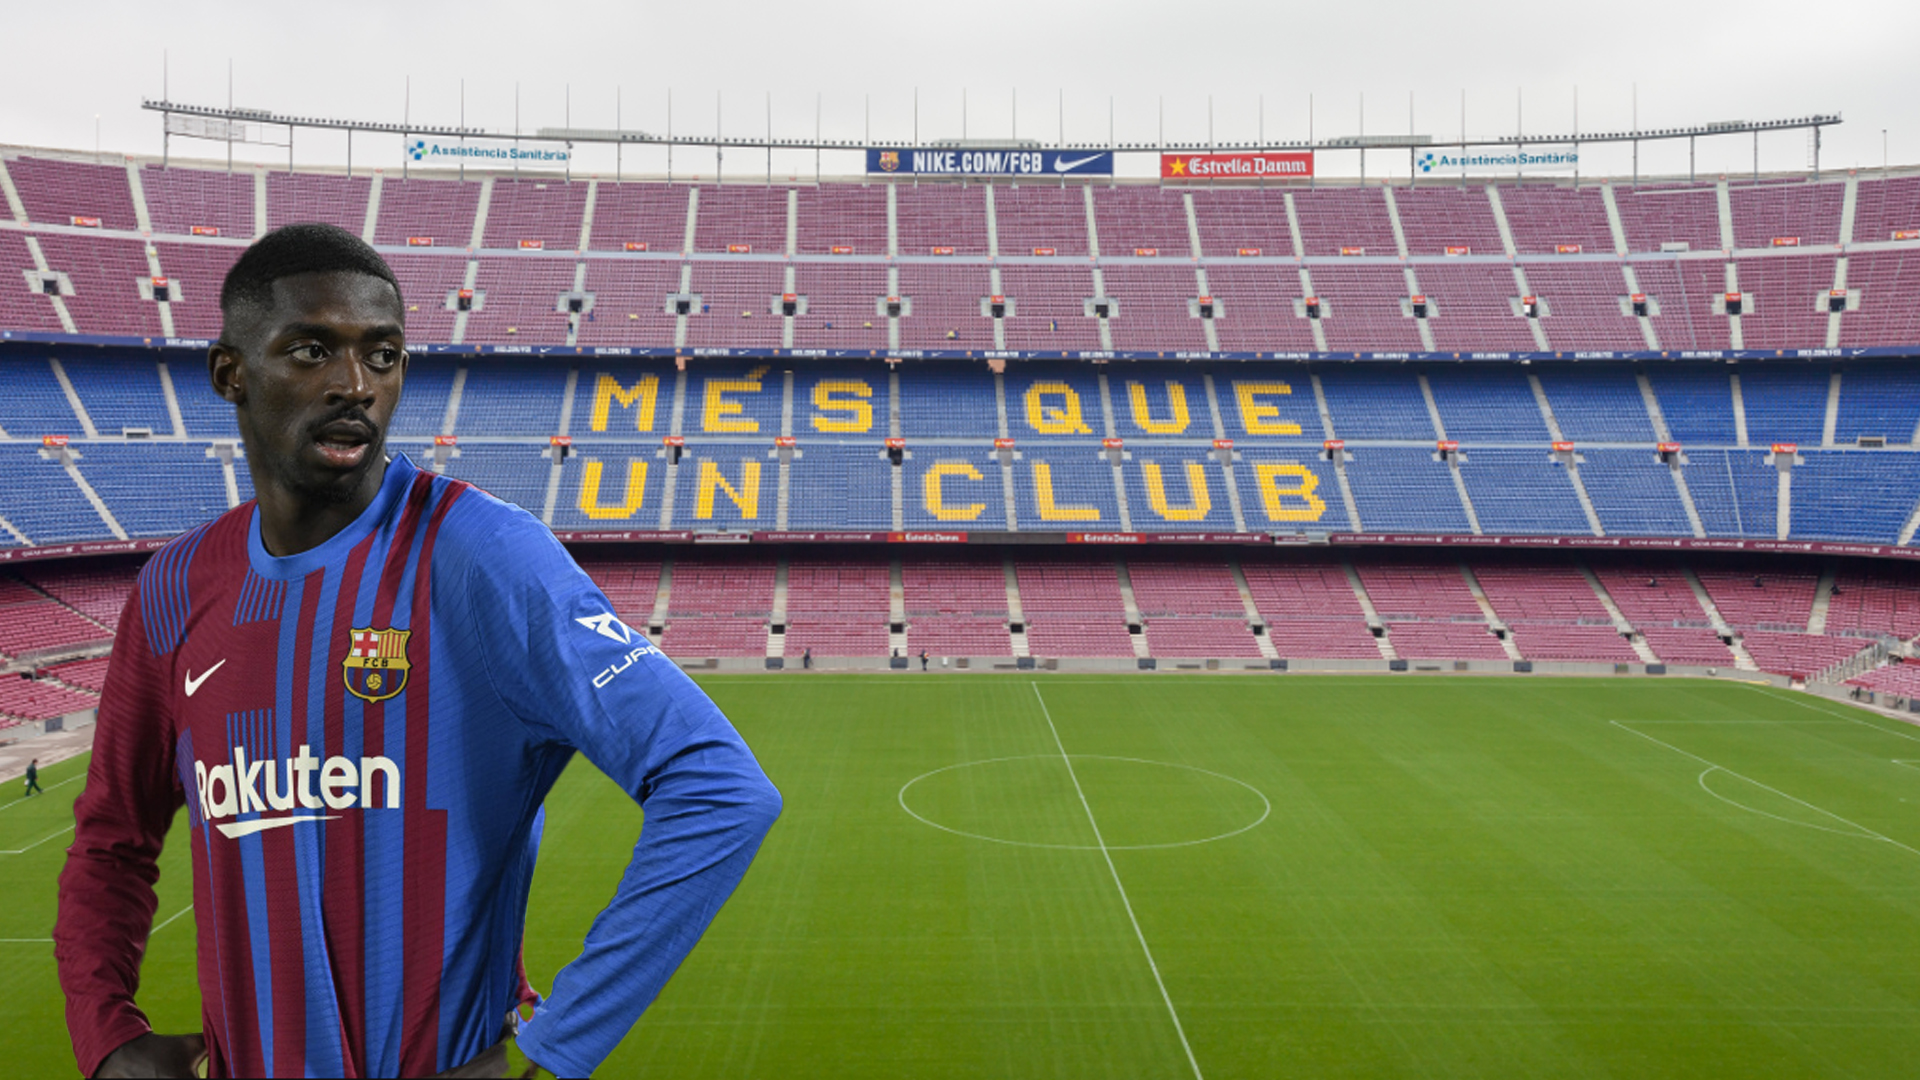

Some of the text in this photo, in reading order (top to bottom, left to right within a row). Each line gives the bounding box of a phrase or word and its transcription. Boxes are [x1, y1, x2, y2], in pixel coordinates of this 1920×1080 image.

[912, 151, 1042, 173] NIKE.COM/FCB
[1188, 156, 1306, 175] Estrella Damm
[589, 365, 1302, 435] MÉS QUE
[578, 461, 1328, 523] UN CLUB
[194, 744, 400, 823] Rakuten
